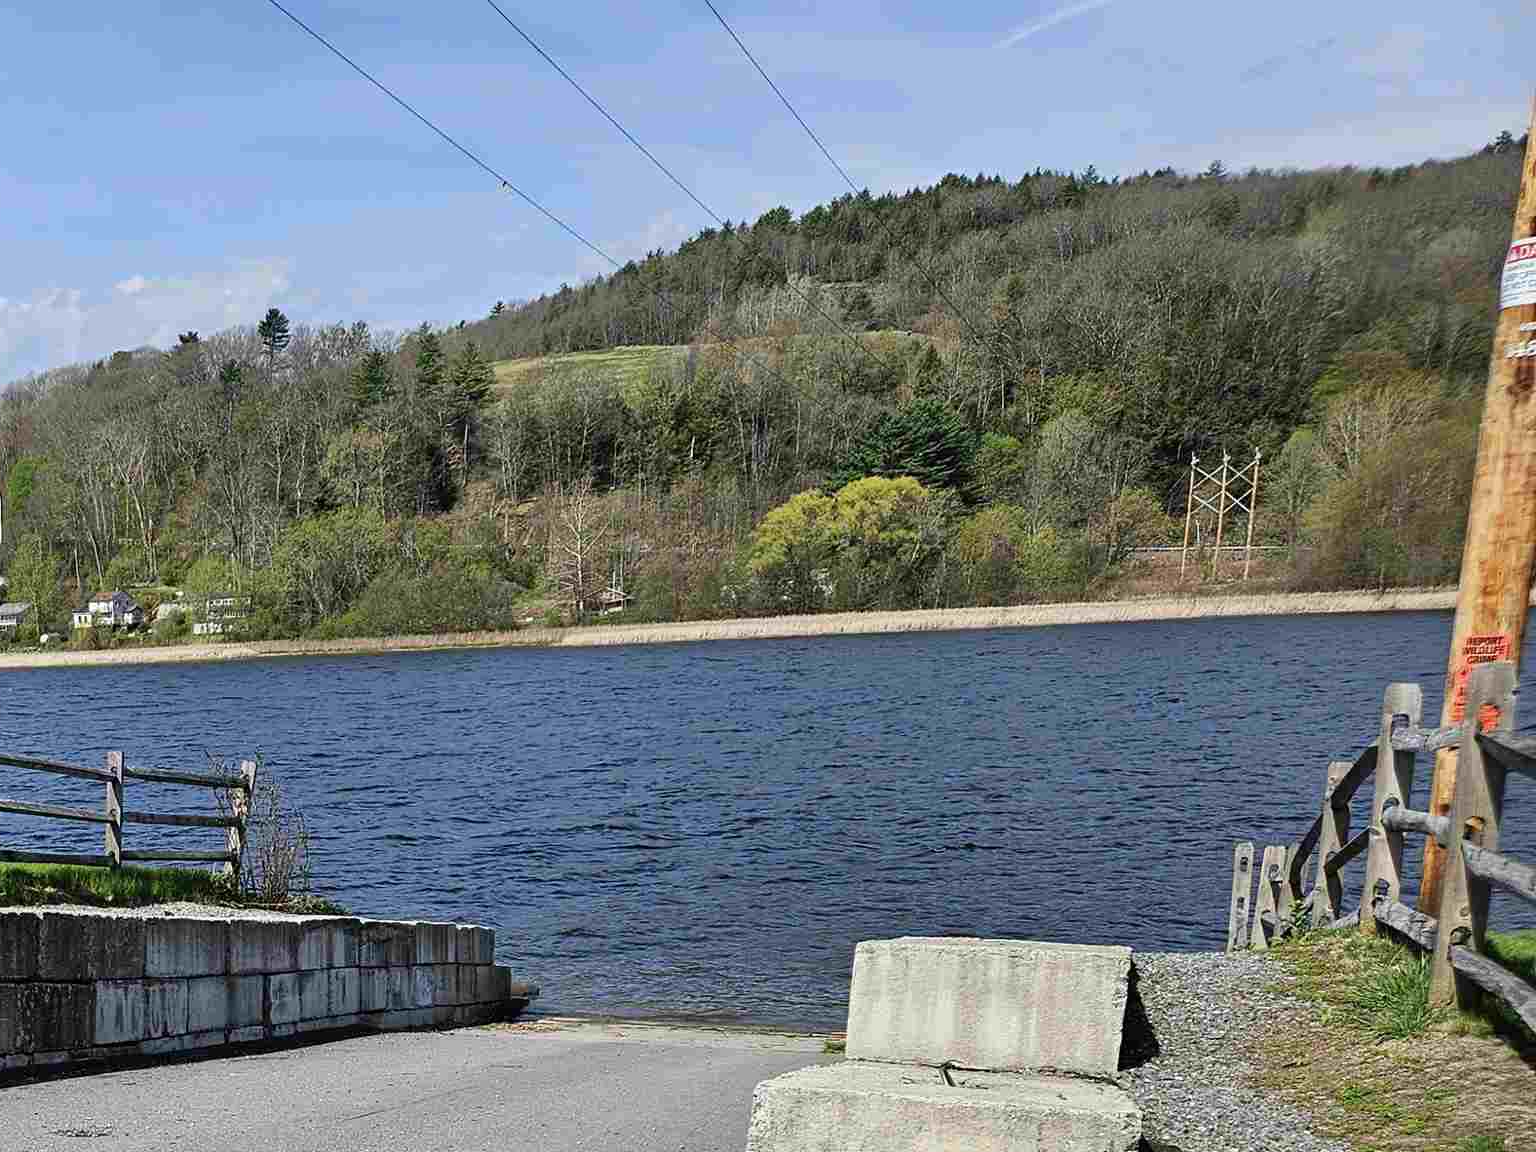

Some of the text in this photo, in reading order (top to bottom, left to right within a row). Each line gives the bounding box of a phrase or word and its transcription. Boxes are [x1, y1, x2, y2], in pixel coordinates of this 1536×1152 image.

[1465, 636, 1504, 646] REPORT
[1463, 646, 1504, 655] WILDLIFE
[1466, 655, 1496, 664] CRIME
